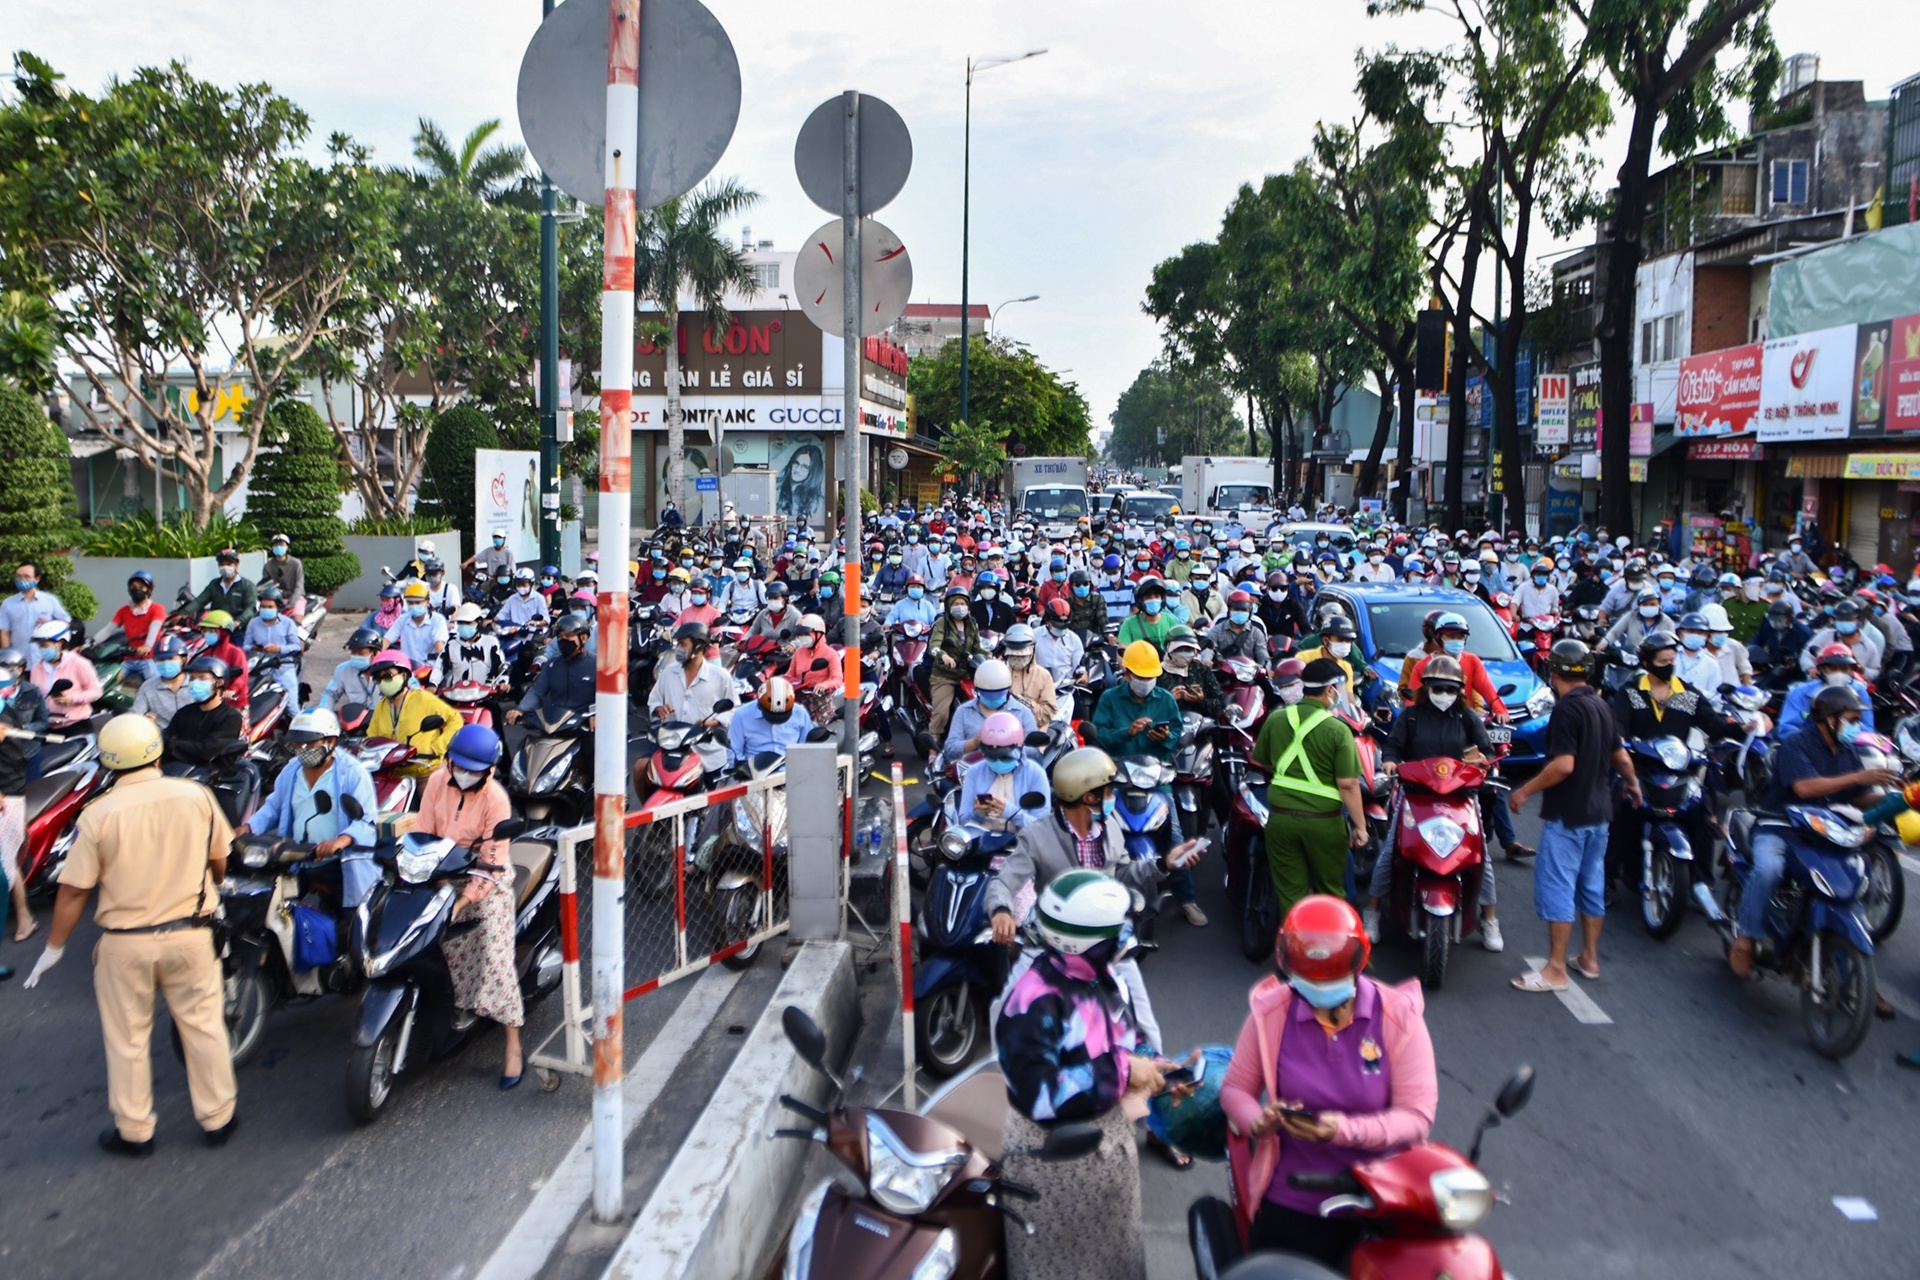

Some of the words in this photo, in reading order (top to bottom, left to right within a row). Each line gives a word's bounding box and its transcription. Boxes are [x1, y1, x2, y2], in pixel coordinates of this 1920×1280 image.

[632, 370, 652, 387] NG
[664, 366, 699, 387] ÁN
[710, 363, 731, 388] LẺ
[743, 364, 774, 388] GIÁ
[786, 363, 804, 388] SỈ
[1542, 377, 1566, 399] IN
[1680, 368, 1717, 407] Oishi
[631, 411, 650, 423] or
[769, 408, 841, 424] GUCCI
[1541, 418, 1565, 426] DECAL
[1764, 408, 1773, 420] XE
[1034, 464, 1043, 473] XE
[855, 1217, 890, 1239] HONDA
